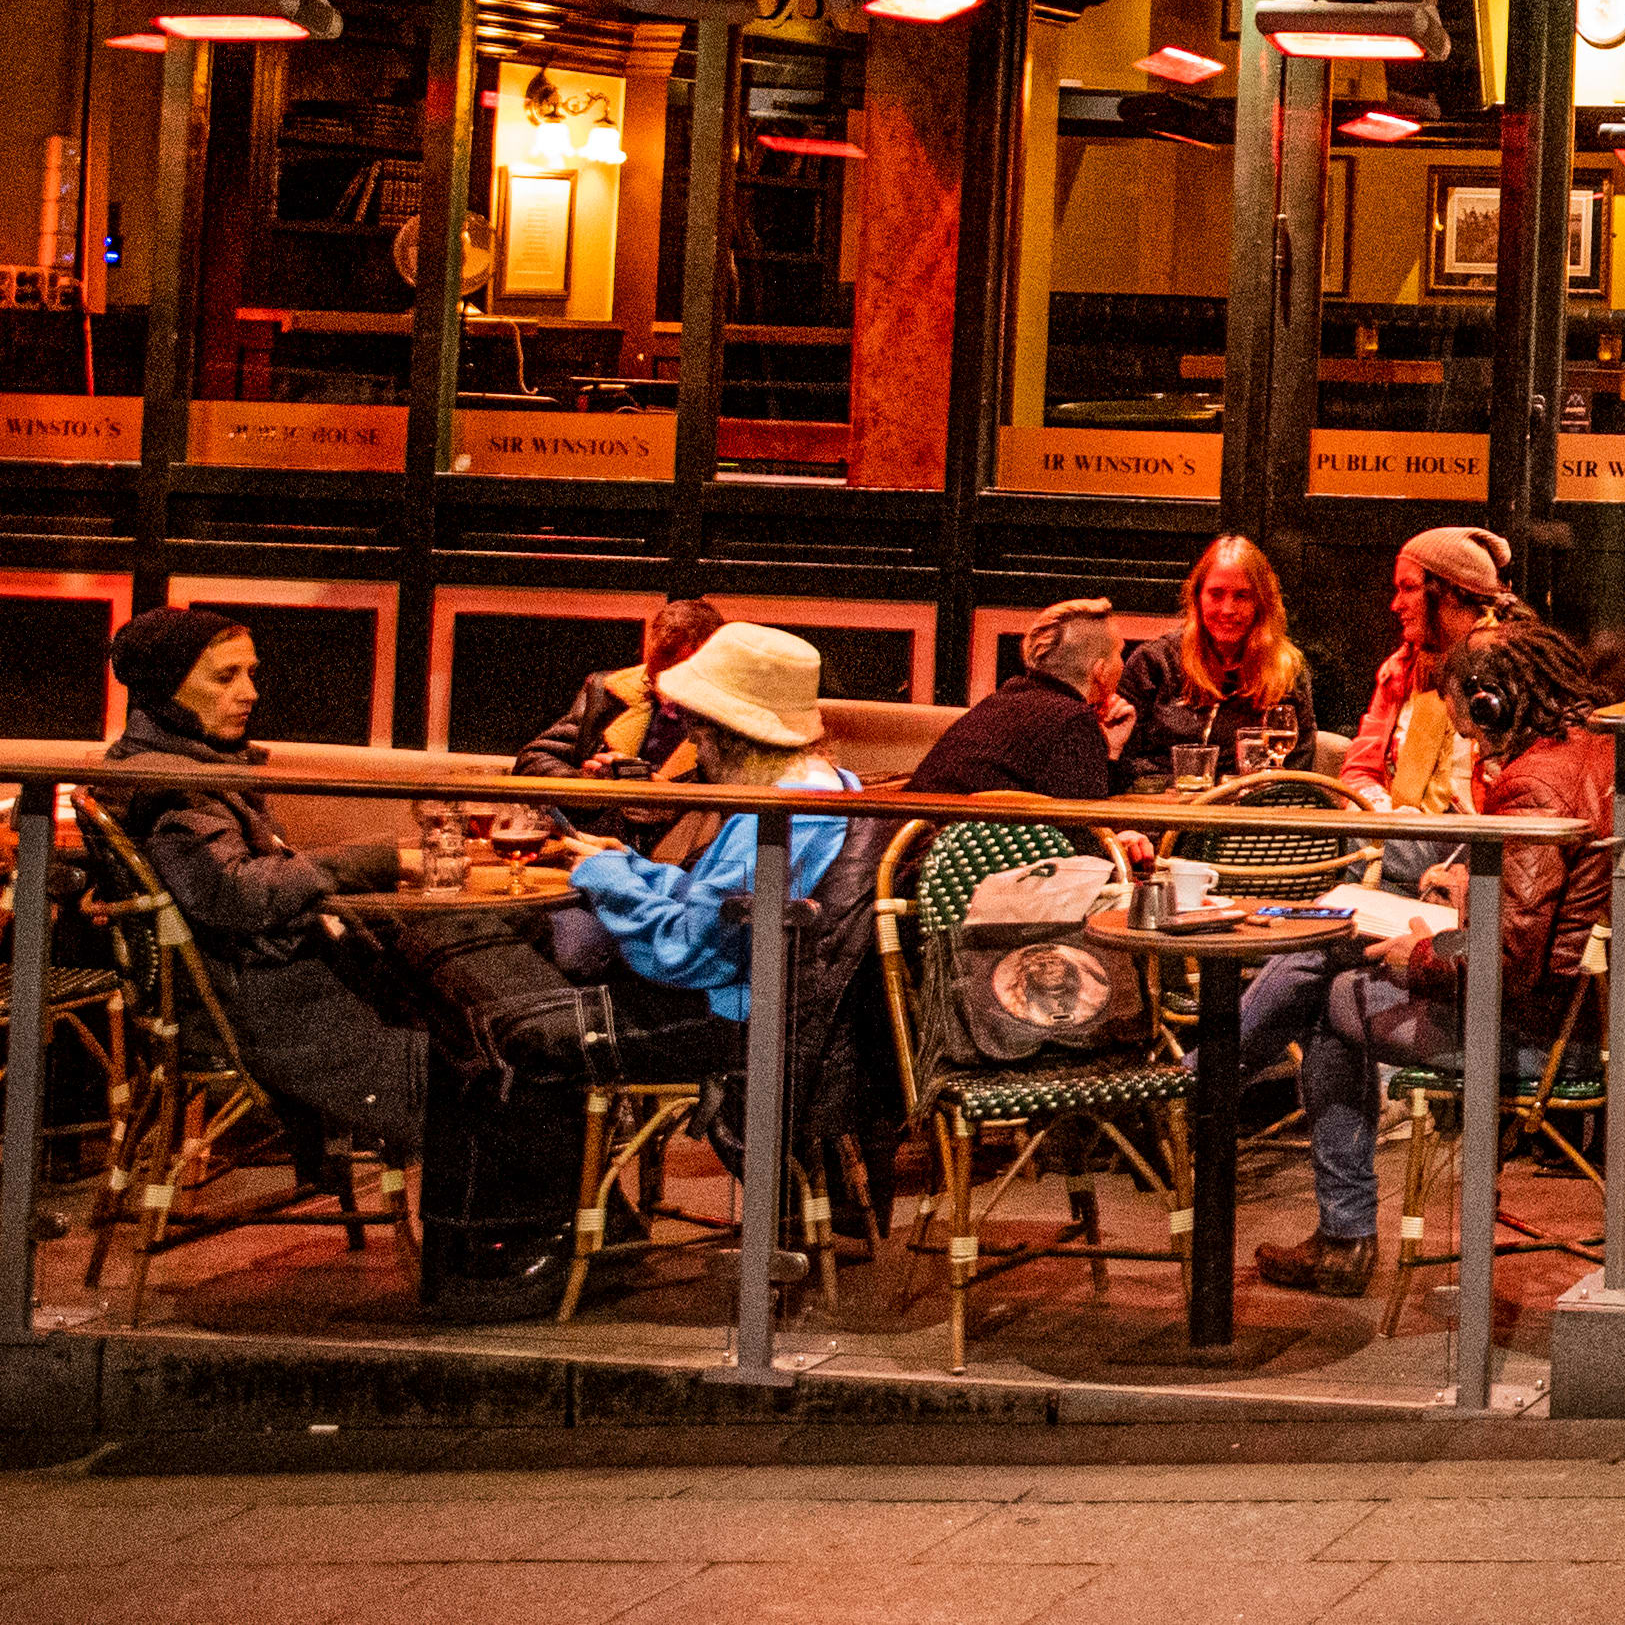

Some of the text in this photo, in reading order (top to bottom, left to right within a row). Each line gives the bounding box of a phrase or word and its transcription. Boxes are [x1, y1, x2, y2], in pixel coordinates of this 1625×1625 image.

[490, 435, 650, 456] SIR WINSTON'S
[1075, 453, 1196, 475] WINSTON'S
[1317, 453, 1480, 475] PUBLIC HOUSE
[1562, 460, 1598, 478] SIR
